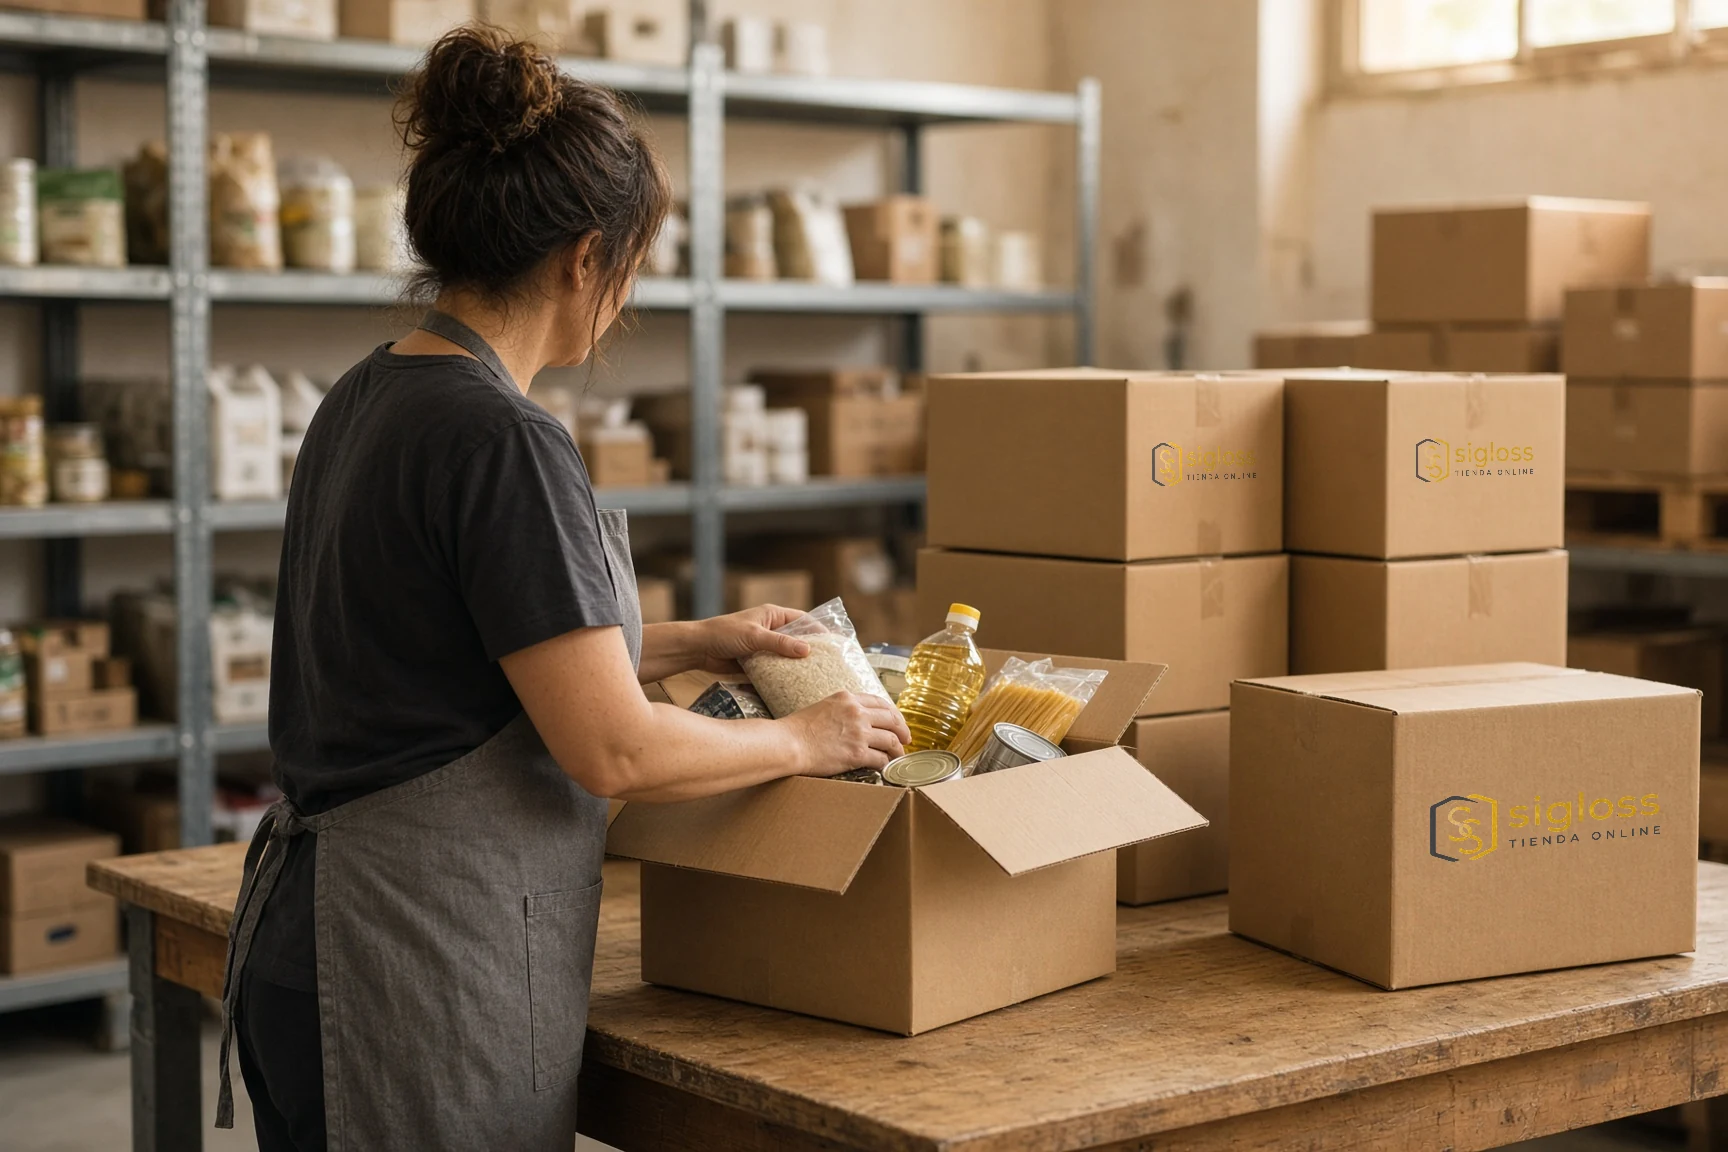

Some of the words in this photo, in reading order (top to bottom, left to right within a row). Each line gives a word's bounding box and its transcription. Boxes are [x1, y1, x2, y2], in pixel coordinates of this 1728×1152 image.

[1186, 445, 1257, 472] sigloss
[1454, 441, 1534, 468] sigloss
[1508, 791, 1660, 833] sigloss
[1508, 833, 1580, 849] TIENDA
[1591, 825, 1661, 841] ONLINE
